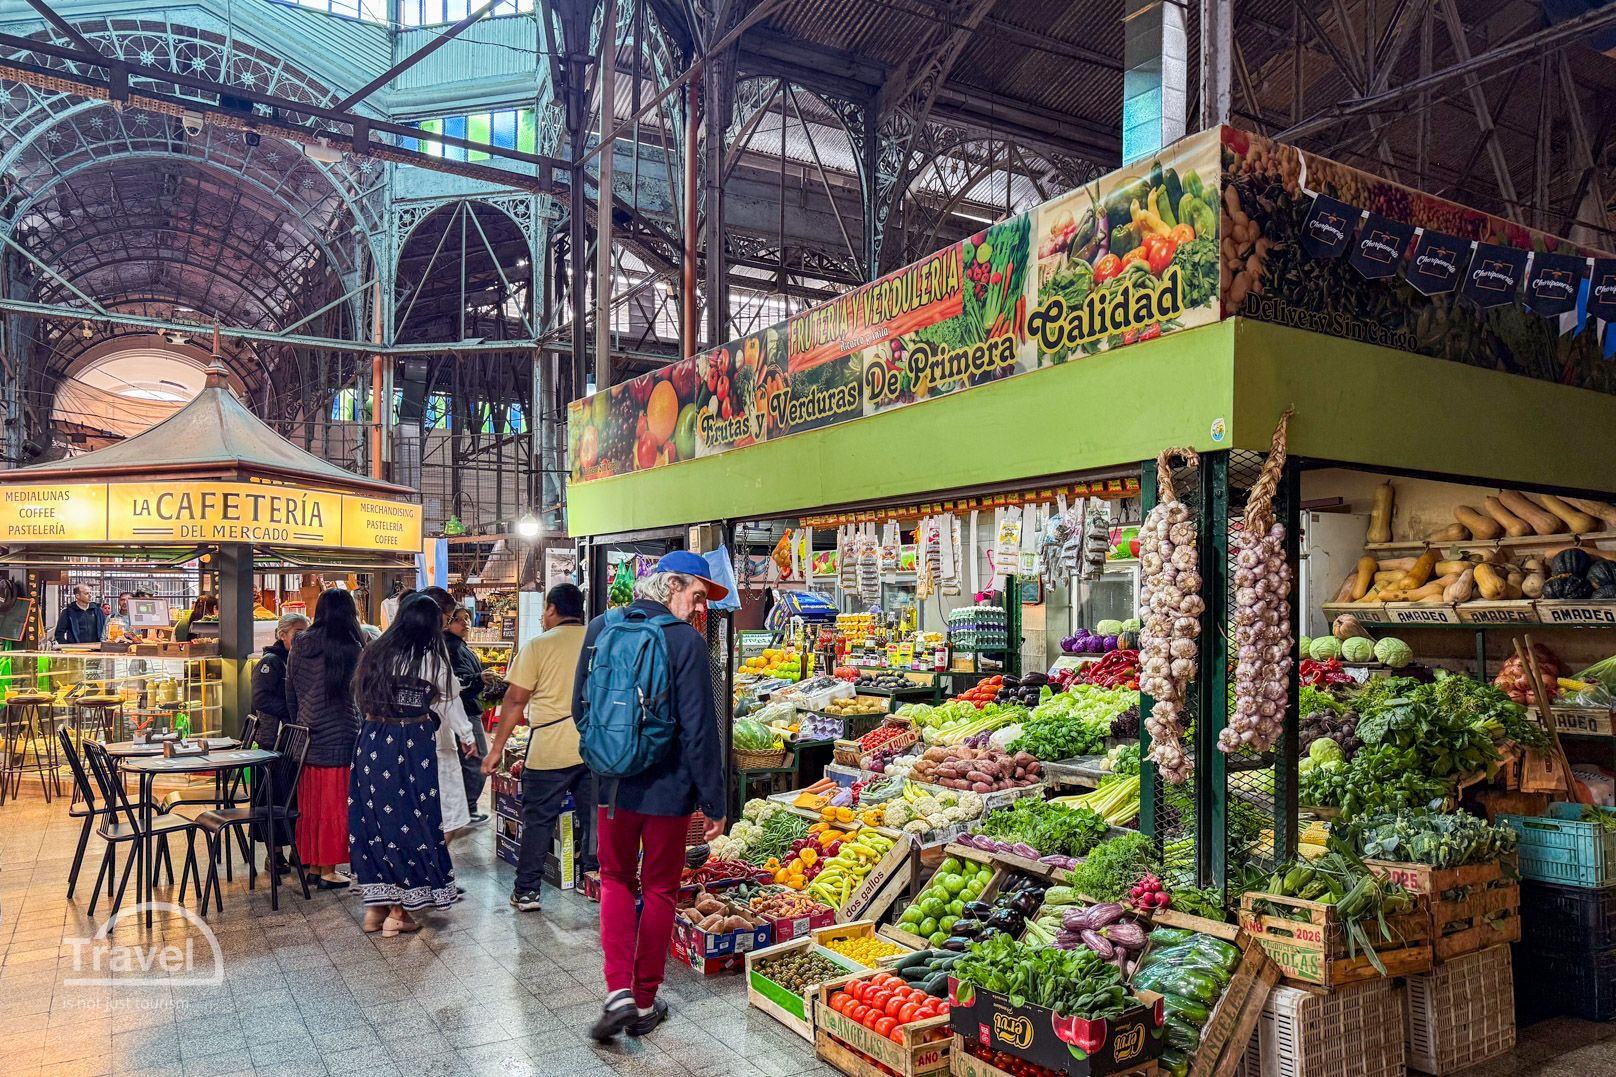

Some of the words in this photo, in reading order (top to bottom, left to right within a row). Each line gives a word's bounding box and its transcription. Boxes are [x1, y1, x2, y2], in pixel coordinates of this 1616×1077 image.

[789, 299, 849, 357] FRUTERIA
[851, 290, 861, 331] Y
[862, 246, 960, 328] VERDULERIA
[1246, 291, 1329, 335] Delivery
[1332, 311, 1364, 341] Sin
[1367, 319, 1418, 351] Cargo
[700, 412, 750, 445] Frutas
[754, 411, 766, 439] y
[769, 382, 858, 427] Verduras
[864, 359, 900, 402] De
[907, 334, 1016, 390] Primera
[1027, 267, 1182, 350] Calidad
[5, 490, 70, 502] MEDIALUNAS
[19, 507, 56, 518] COFFEE
[133, 499, 152, 516] LA
[155, 492, 323, 528] CAFETERÍA
[360, 503, 414, 518] MERCHANDISING
[8, 521, 66, 535] PASTELERÍA
[366, 519, 404, 532] PASTELERÍA
[180, 525, 204, 538] DEL
[212, 525, 289, 541] MERCADO
[374, 534, 399, 545] COFFEE
[1397, 611, 1449, 623] AMADEO
[1471, 610, 1528, 623] AMADEO
[1551, 609, 1615, 622] AMADEO
[846, 900, 861, 917] dos
[861, 871, 884, 901] gallos
[1296, 928, 1321, 943] 2026
